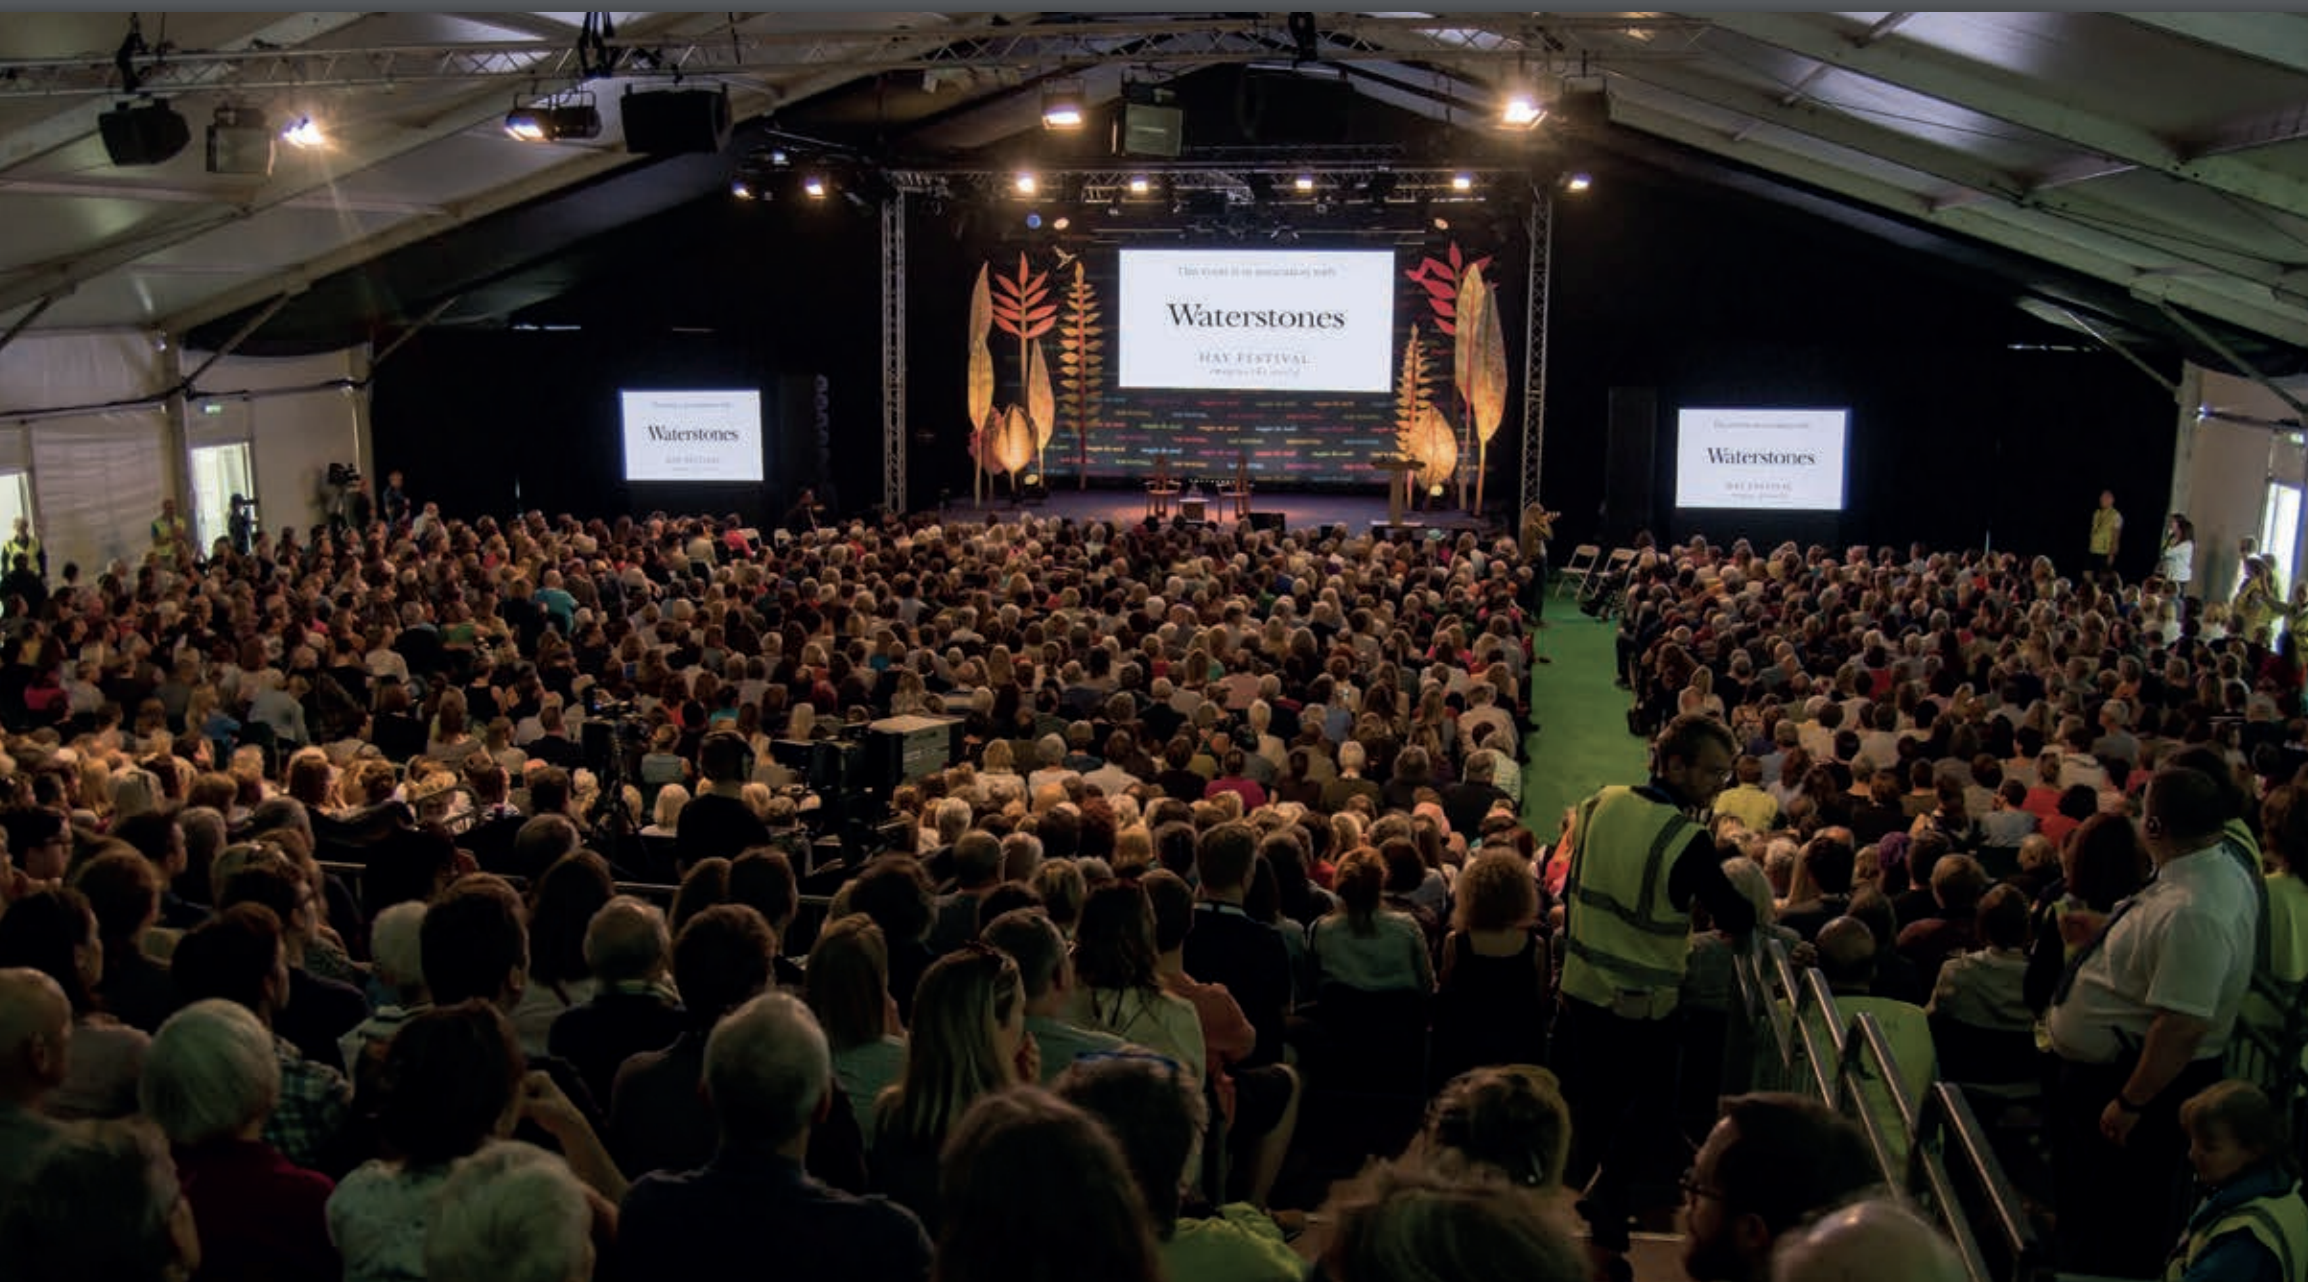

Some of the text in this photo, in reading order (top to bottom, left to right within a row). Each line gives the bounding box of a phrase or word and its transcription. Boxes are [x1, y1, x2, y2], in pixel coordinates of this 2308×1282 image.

[1167, 302, 1346, 329] Waterstones
[1200, 352, 1230, 363] HAY
[648, 424, 740, 441] Waterstones
[1707, 447, 1816, 465] Waterstones
